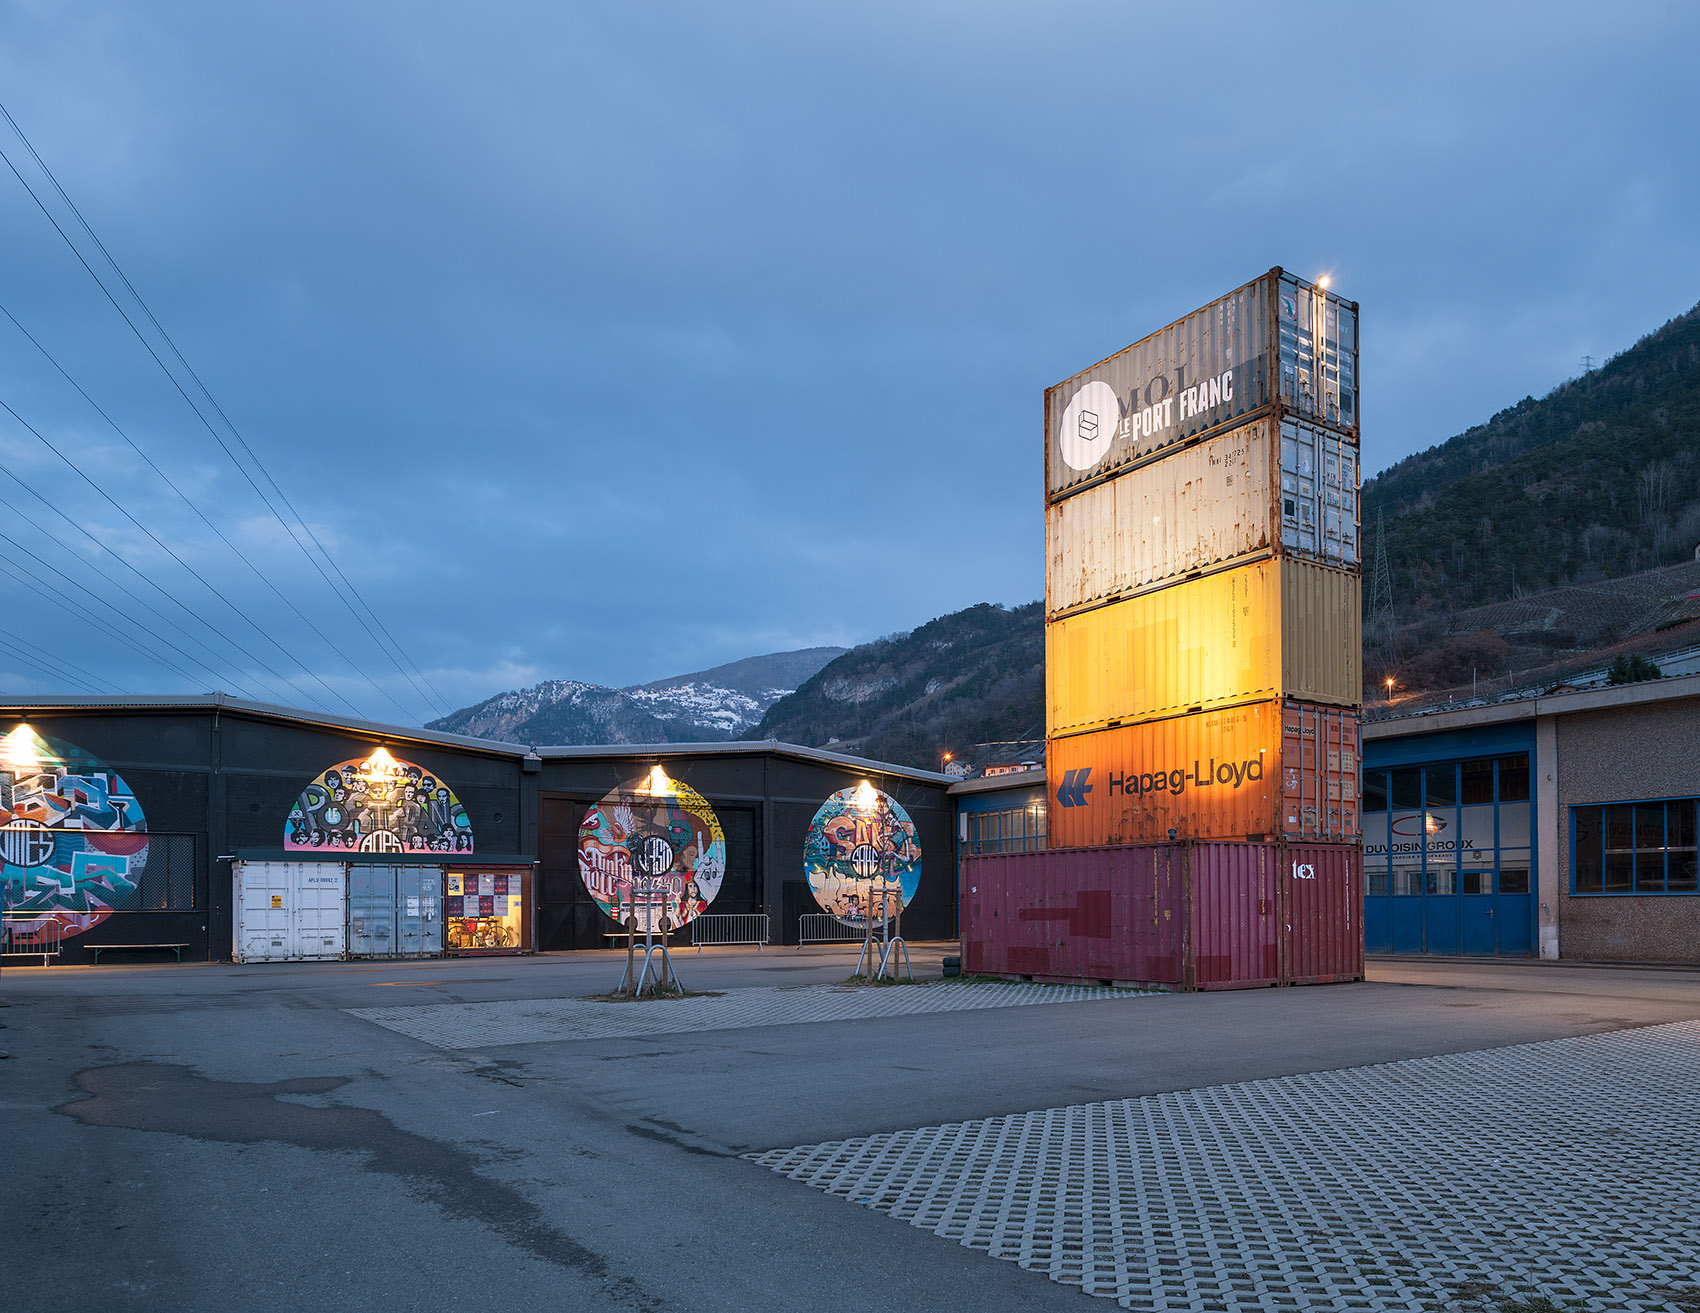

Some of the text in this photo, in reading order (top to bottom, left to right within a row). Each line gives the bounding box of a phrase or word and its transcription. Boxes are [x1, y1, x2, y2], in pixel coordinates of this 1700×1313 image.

[1120, 370, 1232, 441] LE PORT FRANC
[1109, 752, 1264, 797] Hapag-Lloyd
[1292, 859, 1316, 879] tex
